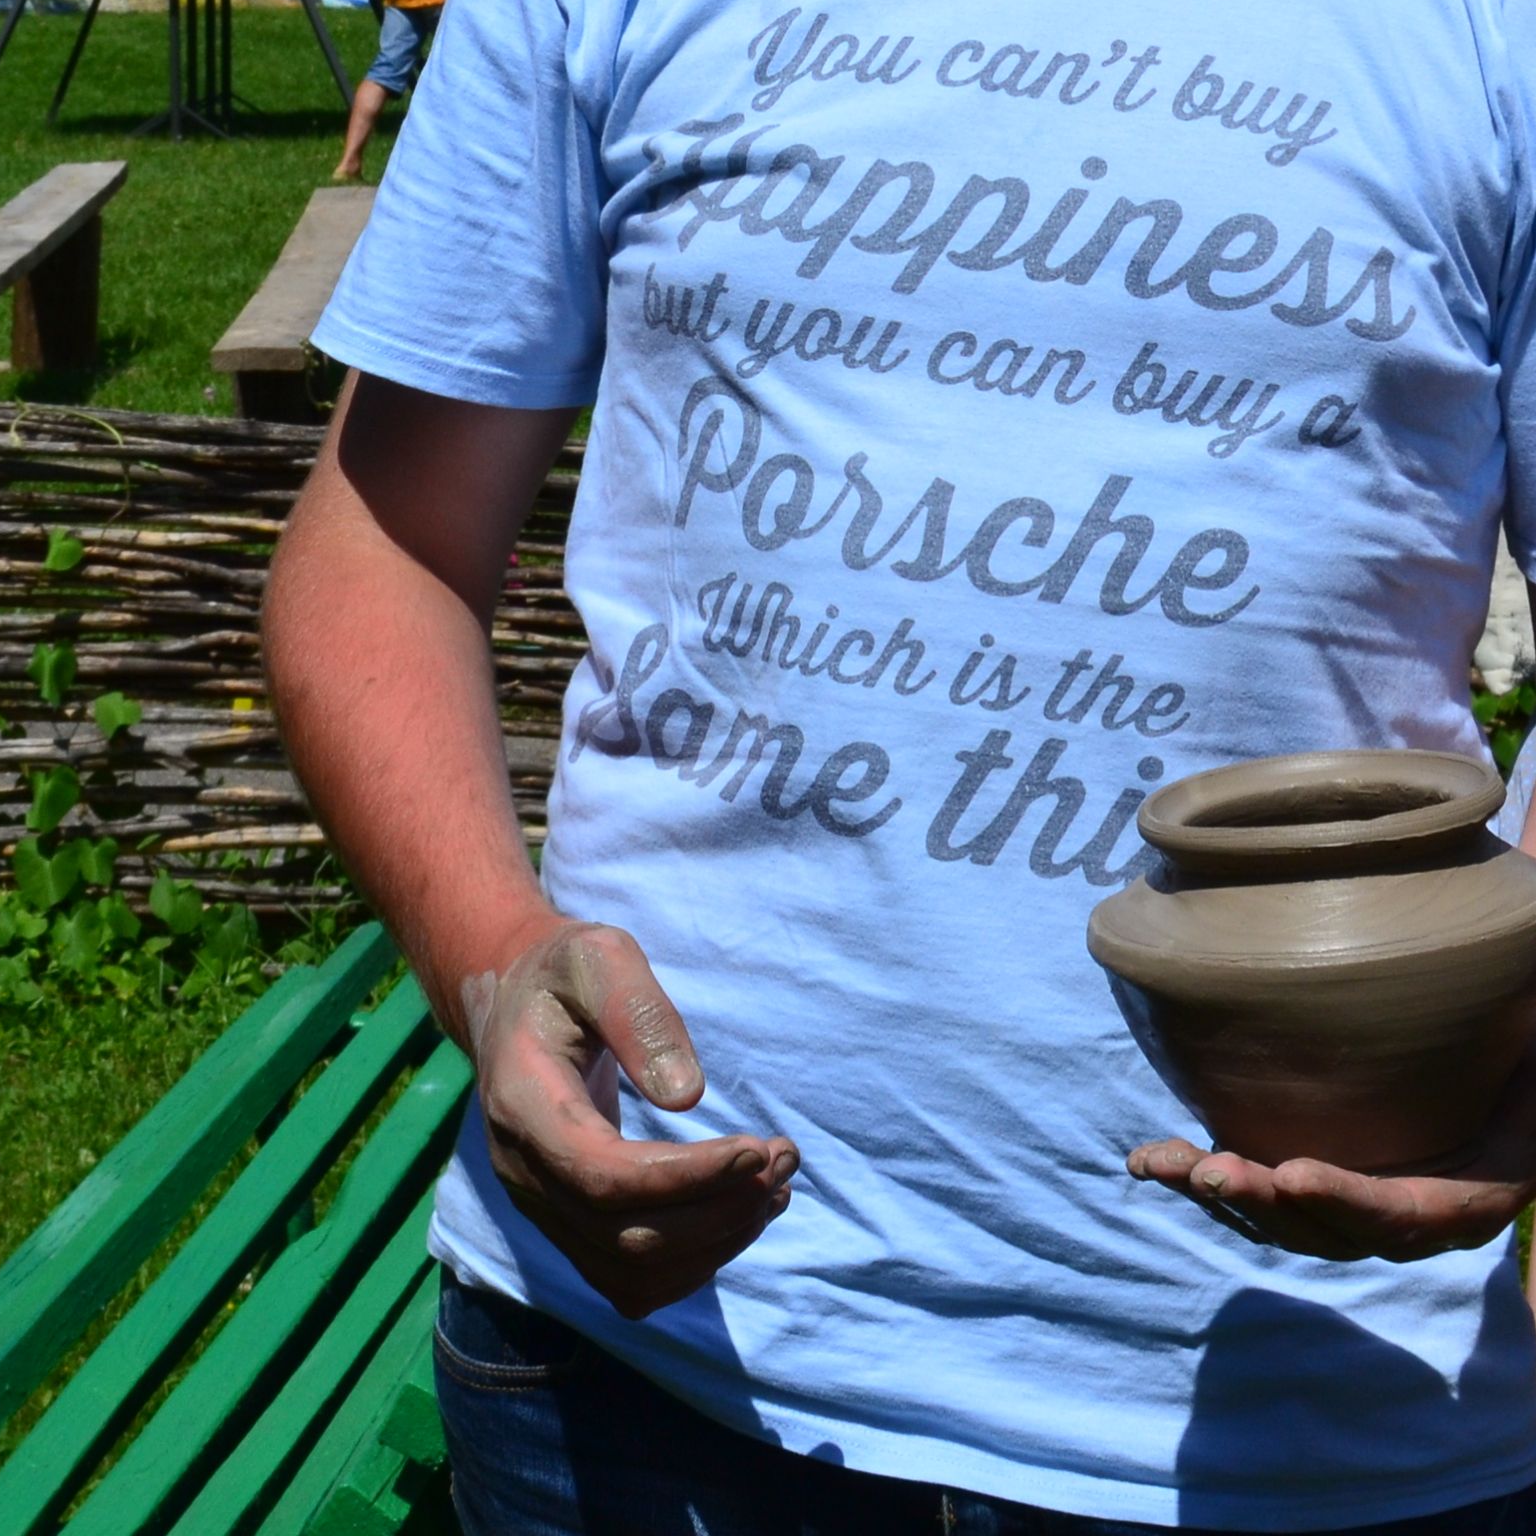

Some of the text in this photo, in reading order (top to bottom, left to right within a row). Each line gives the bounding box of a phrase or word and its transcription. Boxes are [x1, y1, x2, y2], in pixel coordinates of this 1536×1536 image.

[747, 7, 1338, 166] You can't buy
[641, 112, 1416, 342] Happiness
[643, 263, 1362, 459] but you can buy a
[674, 375, 1261, 628] Porsche
[568, 622, 903, 838] Same
[697, 571, 1191, 737] Which is the
